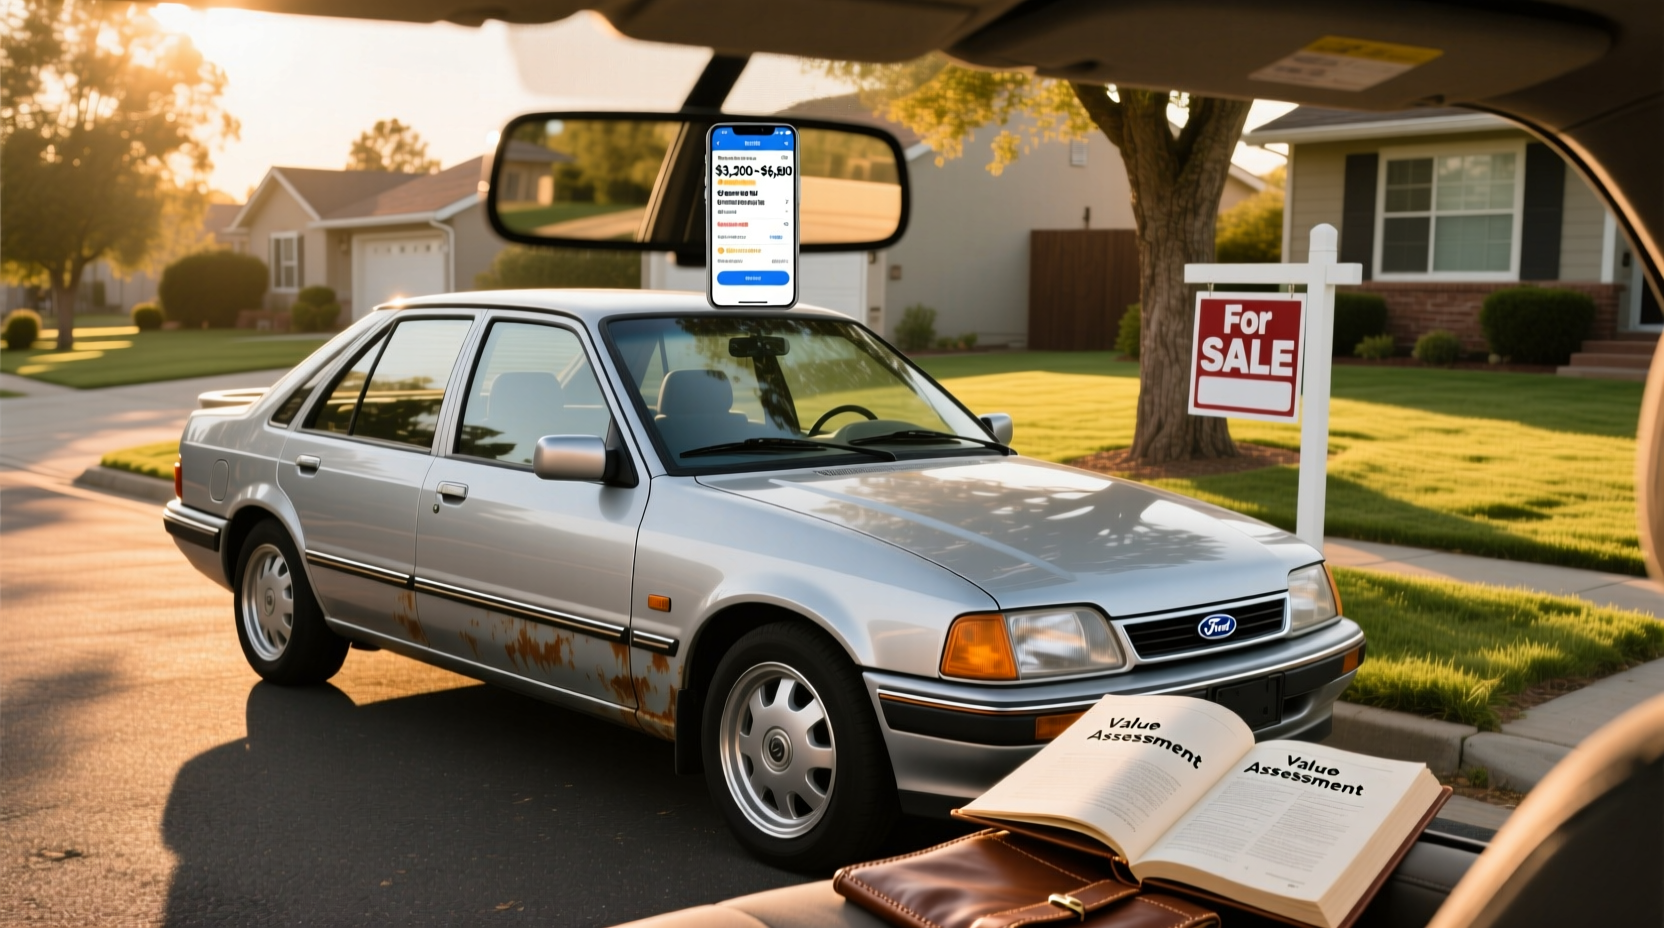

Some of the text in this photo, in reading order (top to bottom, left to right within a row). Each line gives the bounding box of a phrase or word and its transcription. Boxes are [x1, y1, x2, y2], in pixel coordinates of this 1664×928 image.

[1223, 304, 1273, 335] For
[1200, 336, 1295, 377] SALE
[1109, 717, 1161, 731] Value
[1087, 729, 1203, 770] Assessment
[1243, 761, 1364, 797] Assessment
